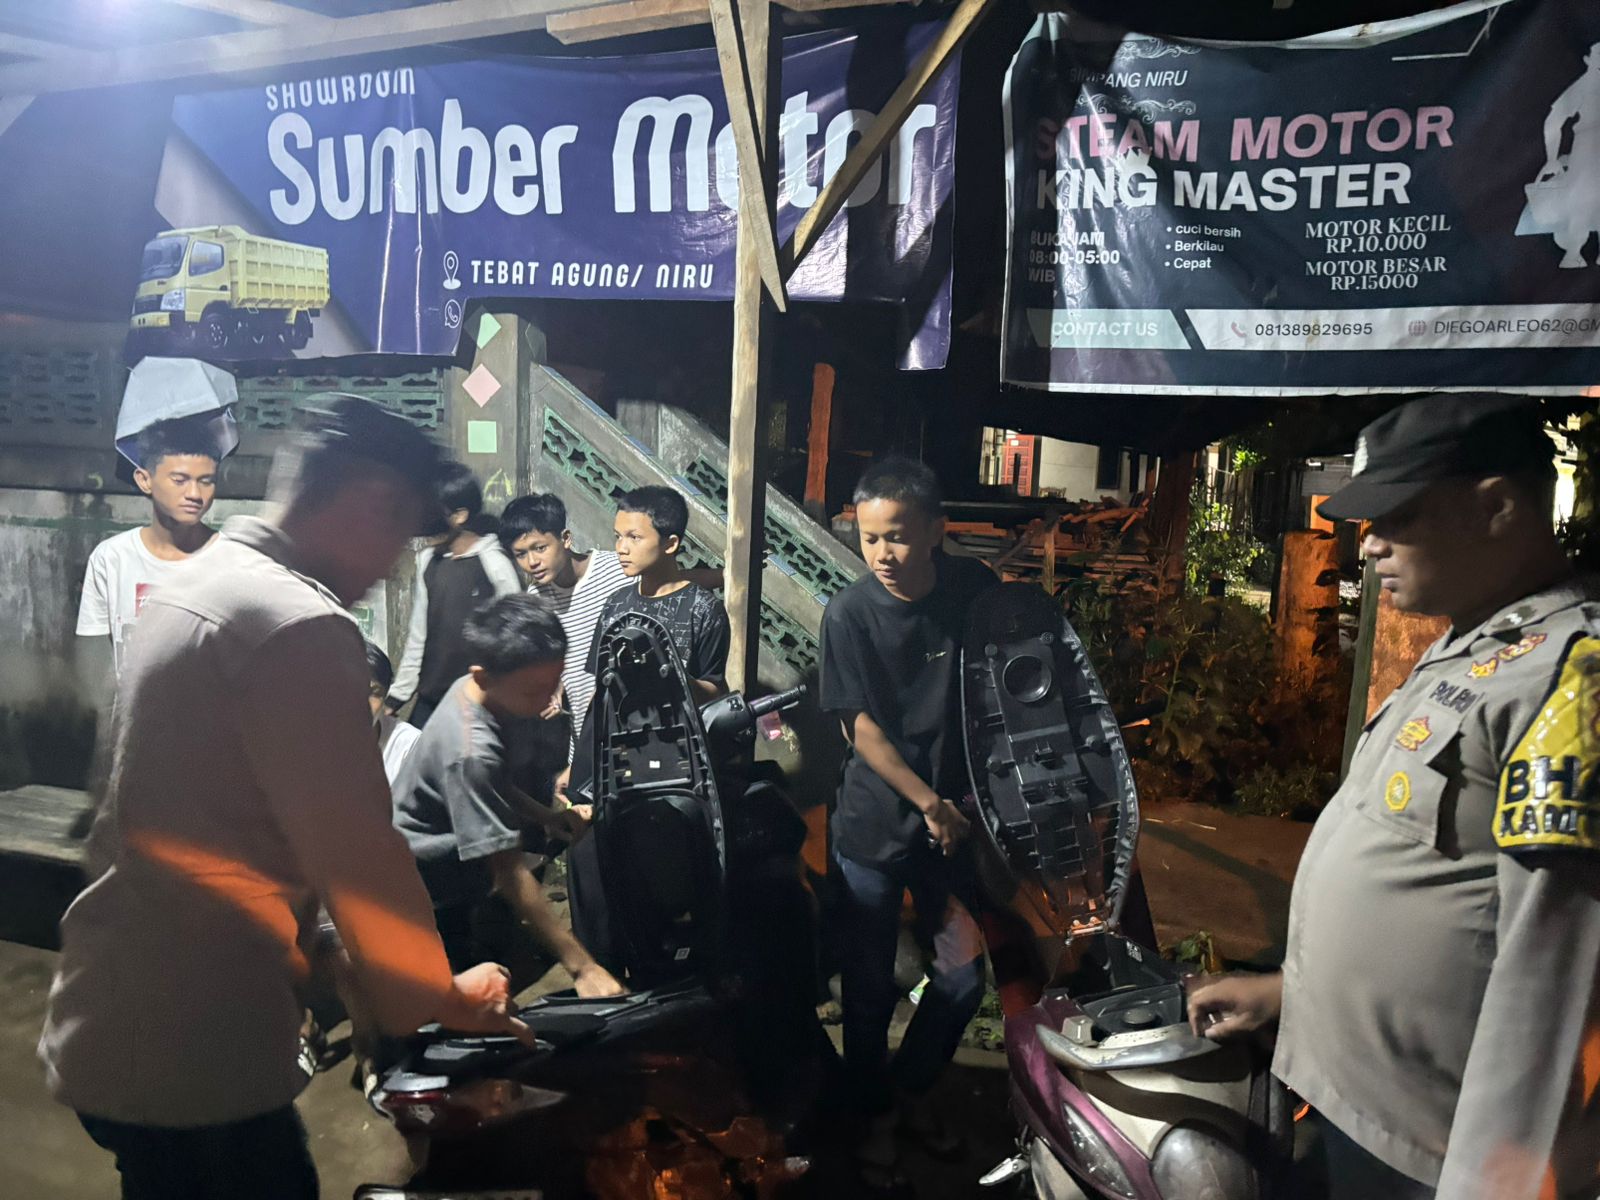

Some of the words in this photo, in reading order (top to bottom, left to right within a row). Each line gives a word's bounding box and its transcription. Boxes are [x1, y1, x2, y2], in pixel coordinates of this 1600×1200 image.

[1145, 70, 1188, 88] NIRU
[265, 67, 415, 111] SHOWROOM
[1037, 113, 1200, 163] STEAM
[1230, 106, 1454, 162] MOTOR
[267, 98, 579, 225] Sumber
[1037, 167, 1158, 210] KING
[1173, 163, 1411, 212] MASTER
[1175, 225, 1201, 235] cuci
[1204, 225, 1241, 238] bersih
[1305, 219, 1383, 239] MOTOR
[1388, 215, 1451, 233] KECIL
[1174, 240, 1224, 252] Berkilau
[1326, 234, 1427, 254] RP.10.000
[1029, 249, 1120, 265] 08:00-05:00
[1173, 257, 1212, 271] Cepat
[1305, 258, 1377, 276] MOTOR
[1383, 256, 1447, 274] BESAR
[471, 260, 539, 285] TEBAT
[551, 262, 644, 288] AGUNG/
[655, 264, 714, 288] NIRU
[1028, 267, 1056, 283] WIB
[1330, 273, 1419, 291] RP.15000
[1053, 322, 1131, 337] CONTACT
[1135, 322, 1158, 336] US
[1254, 322, 1373, 337] 081389829695
